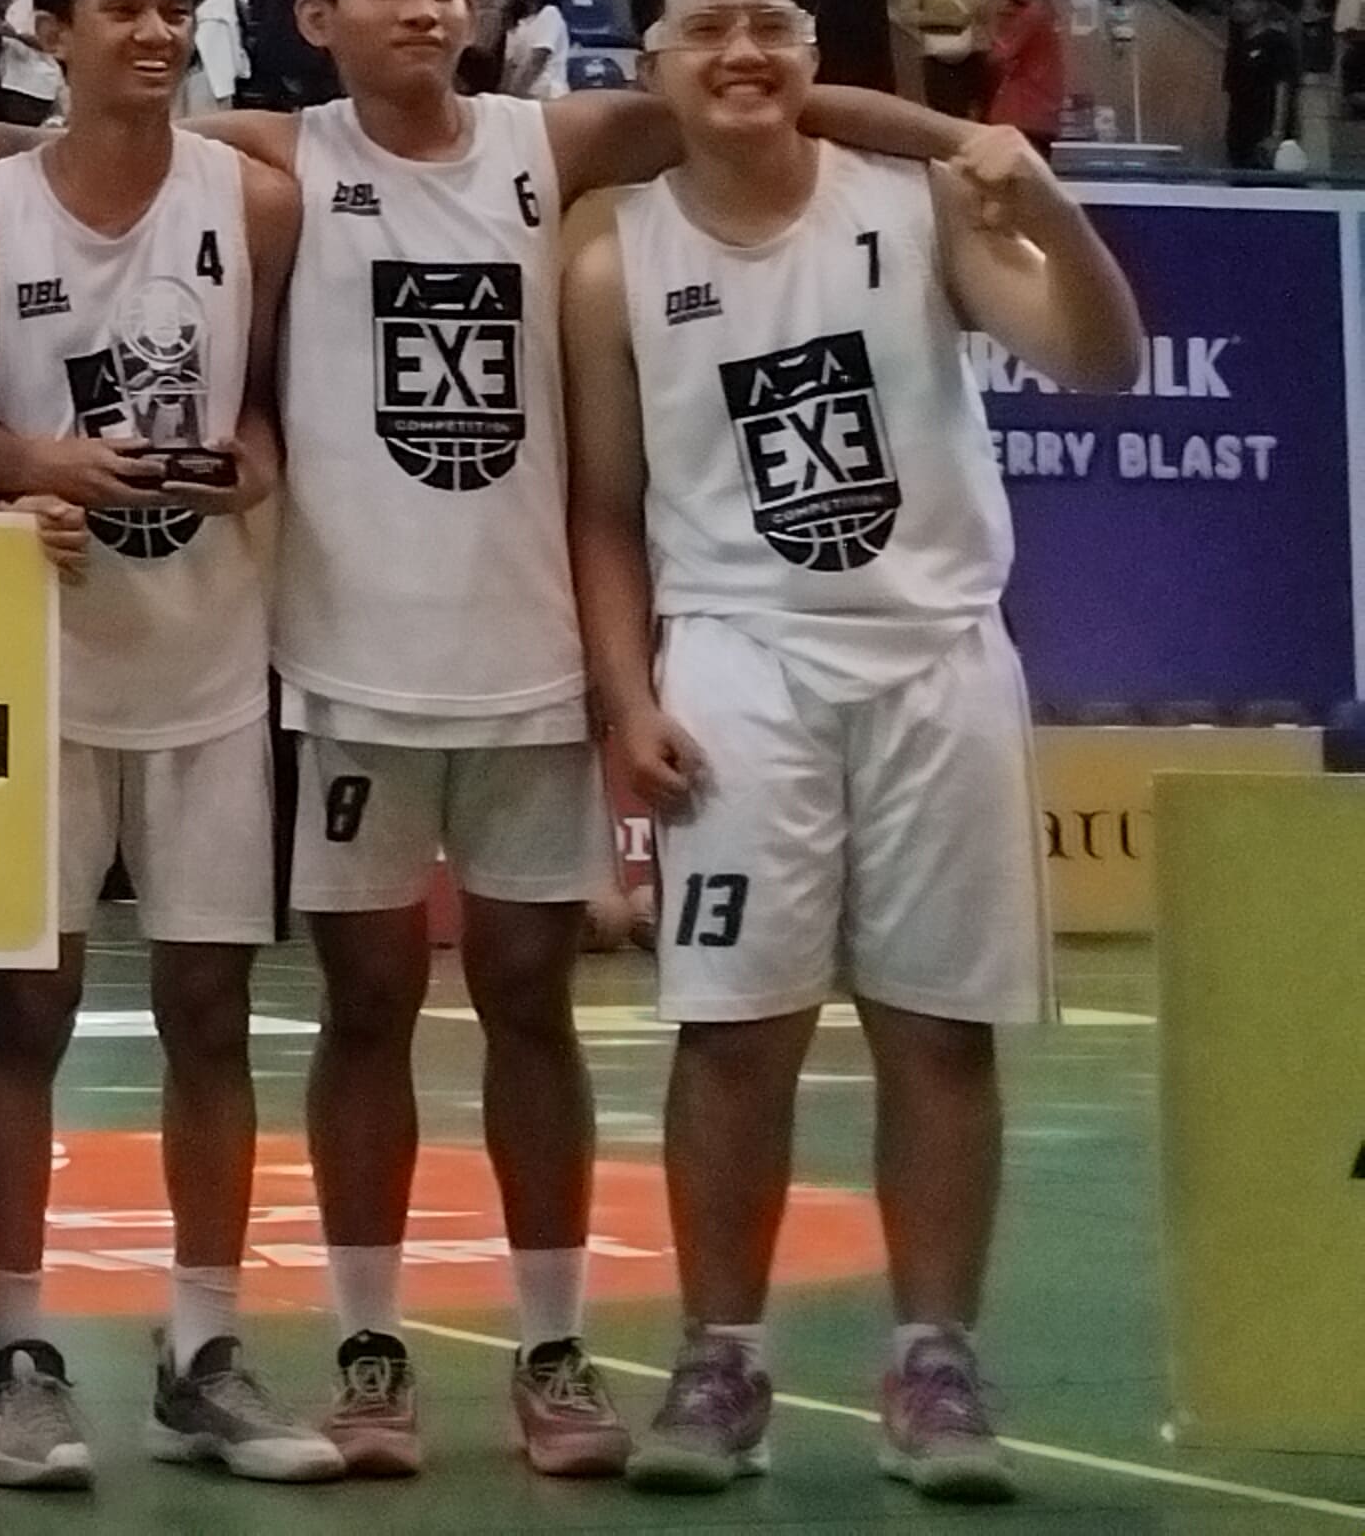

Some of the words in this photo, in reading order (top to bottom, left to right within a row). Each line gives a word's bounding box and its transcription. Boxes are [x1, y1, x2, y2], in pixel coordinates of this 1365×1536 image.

[196, 230, 225, 287] 4
[855, 230, 880, 289] 1
[17, 278, 69, 308] DBL
[665, 282, 721, 317] DBL
[1118, 433, 1277, 480] BLAST
[325, 775, 373, 843] 8
[674, 871, 751, 948] 13
